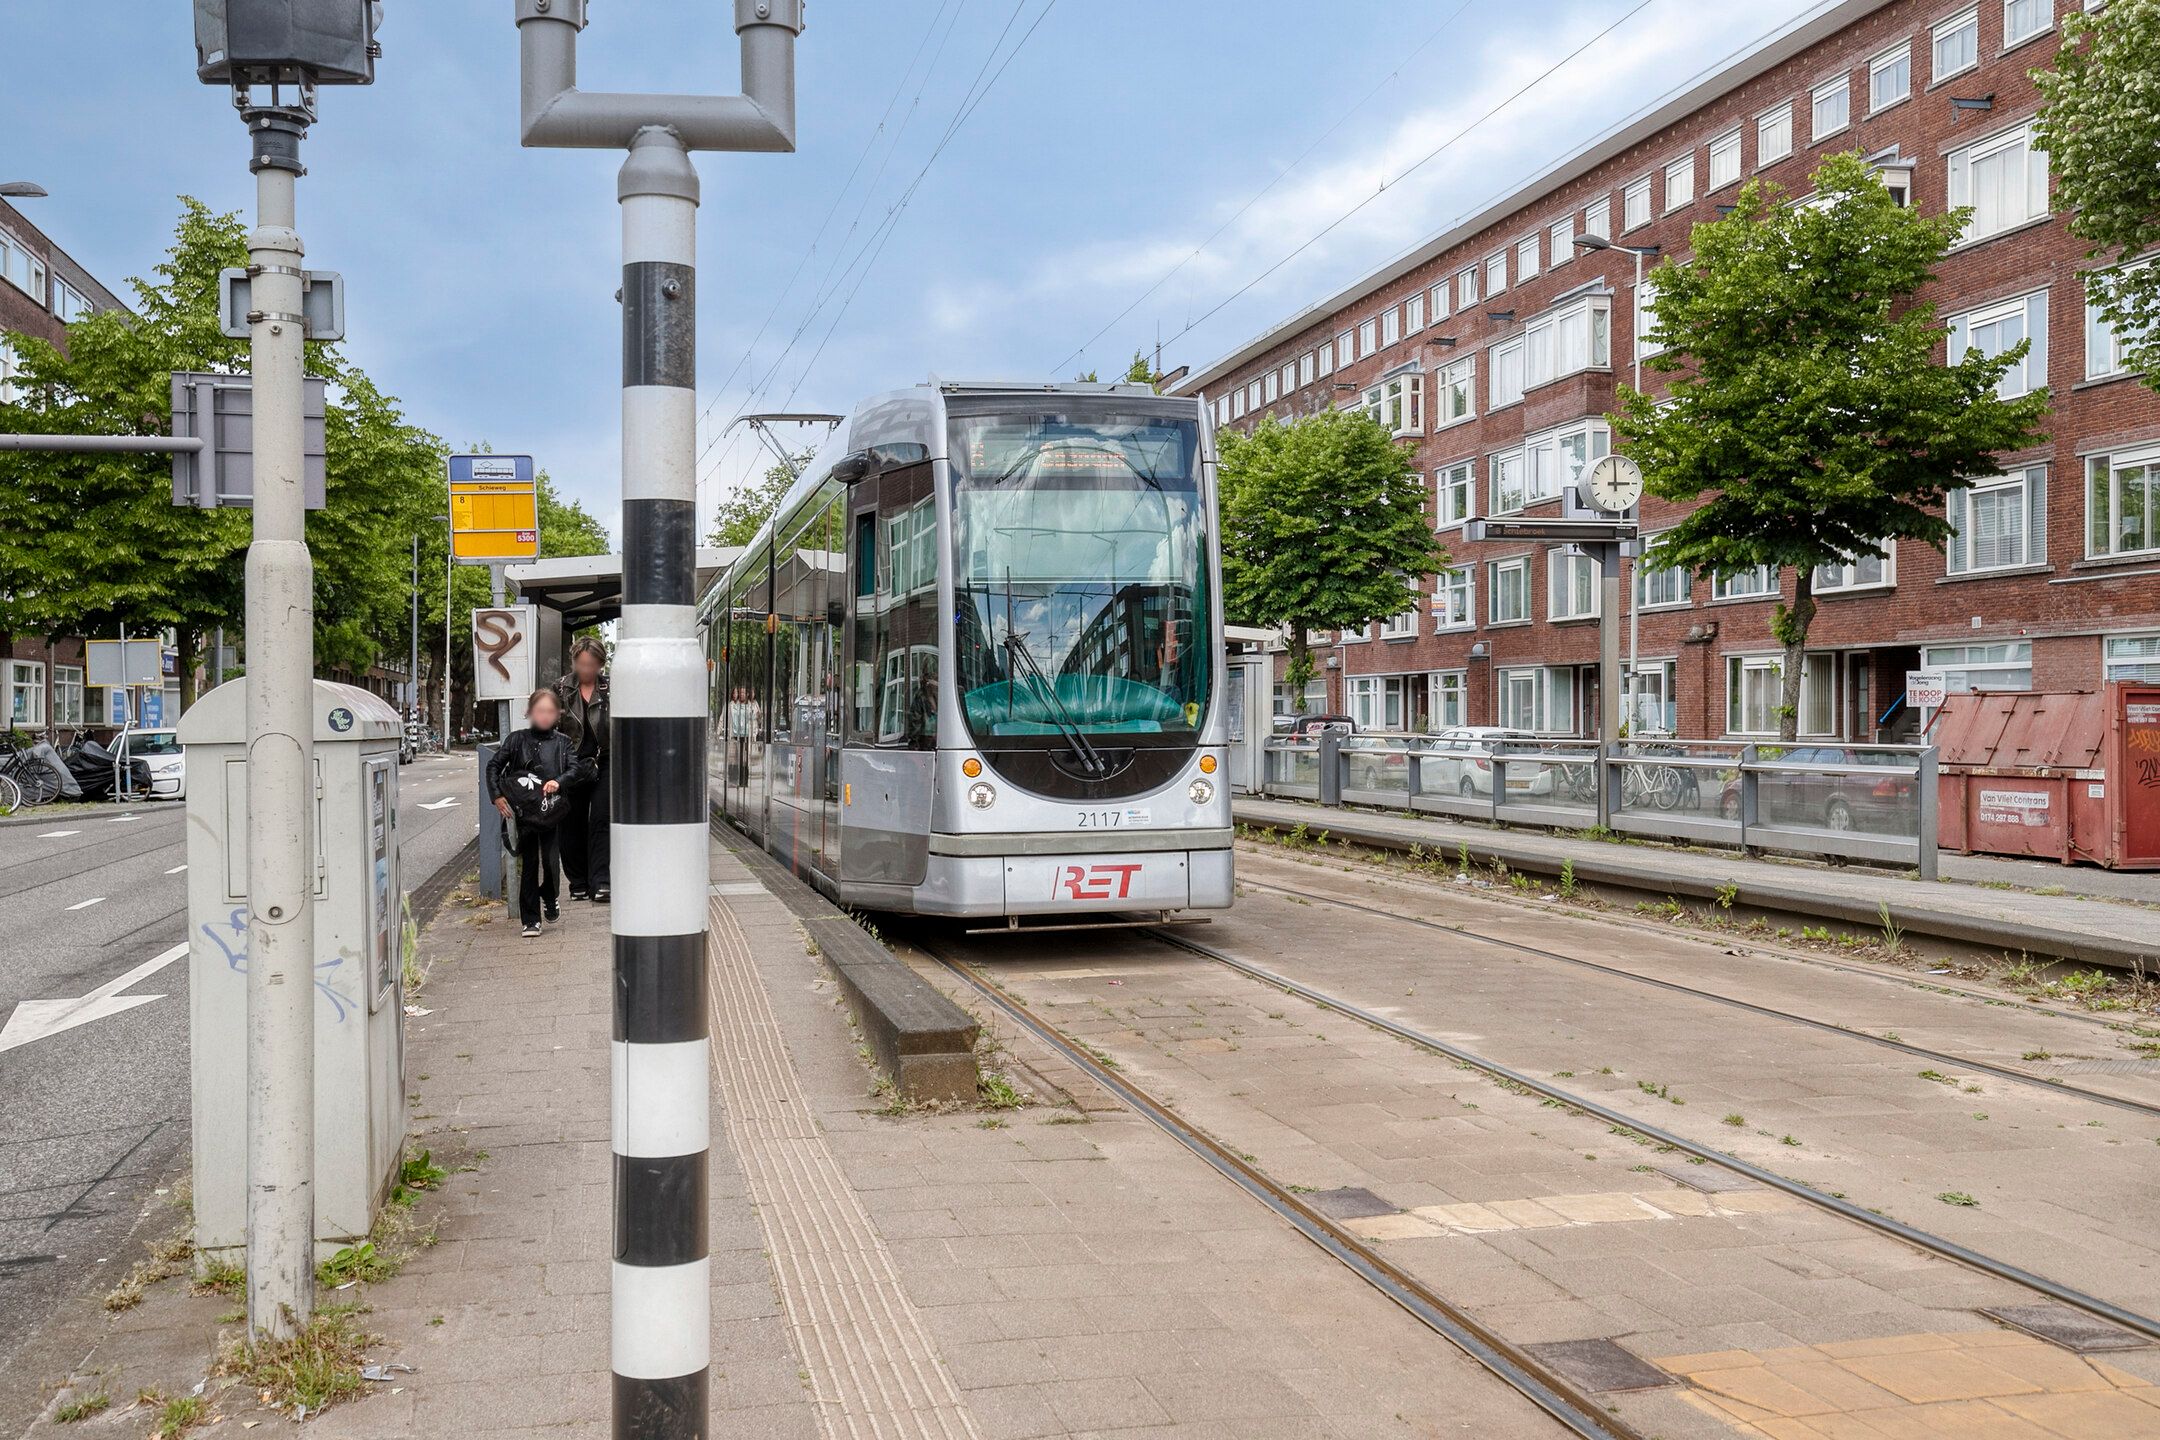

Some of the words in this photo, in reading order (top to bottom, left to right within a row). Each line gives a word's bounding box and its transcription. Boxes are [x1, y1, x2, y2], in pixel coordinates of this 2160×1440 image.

[459, 496, 465, 504] 8
[1982, 793, 1996, 802] Van
[1997, 794, 2013, 803] Vliet
[2013, 795, 2047, 805] Contrans
[1078, 812, 1120, 827] 2117
[1980, 812, 1995, 821] 0174
[1996, 813, 2007, 822] 297
[1064, 864, 1143, 900] RET
